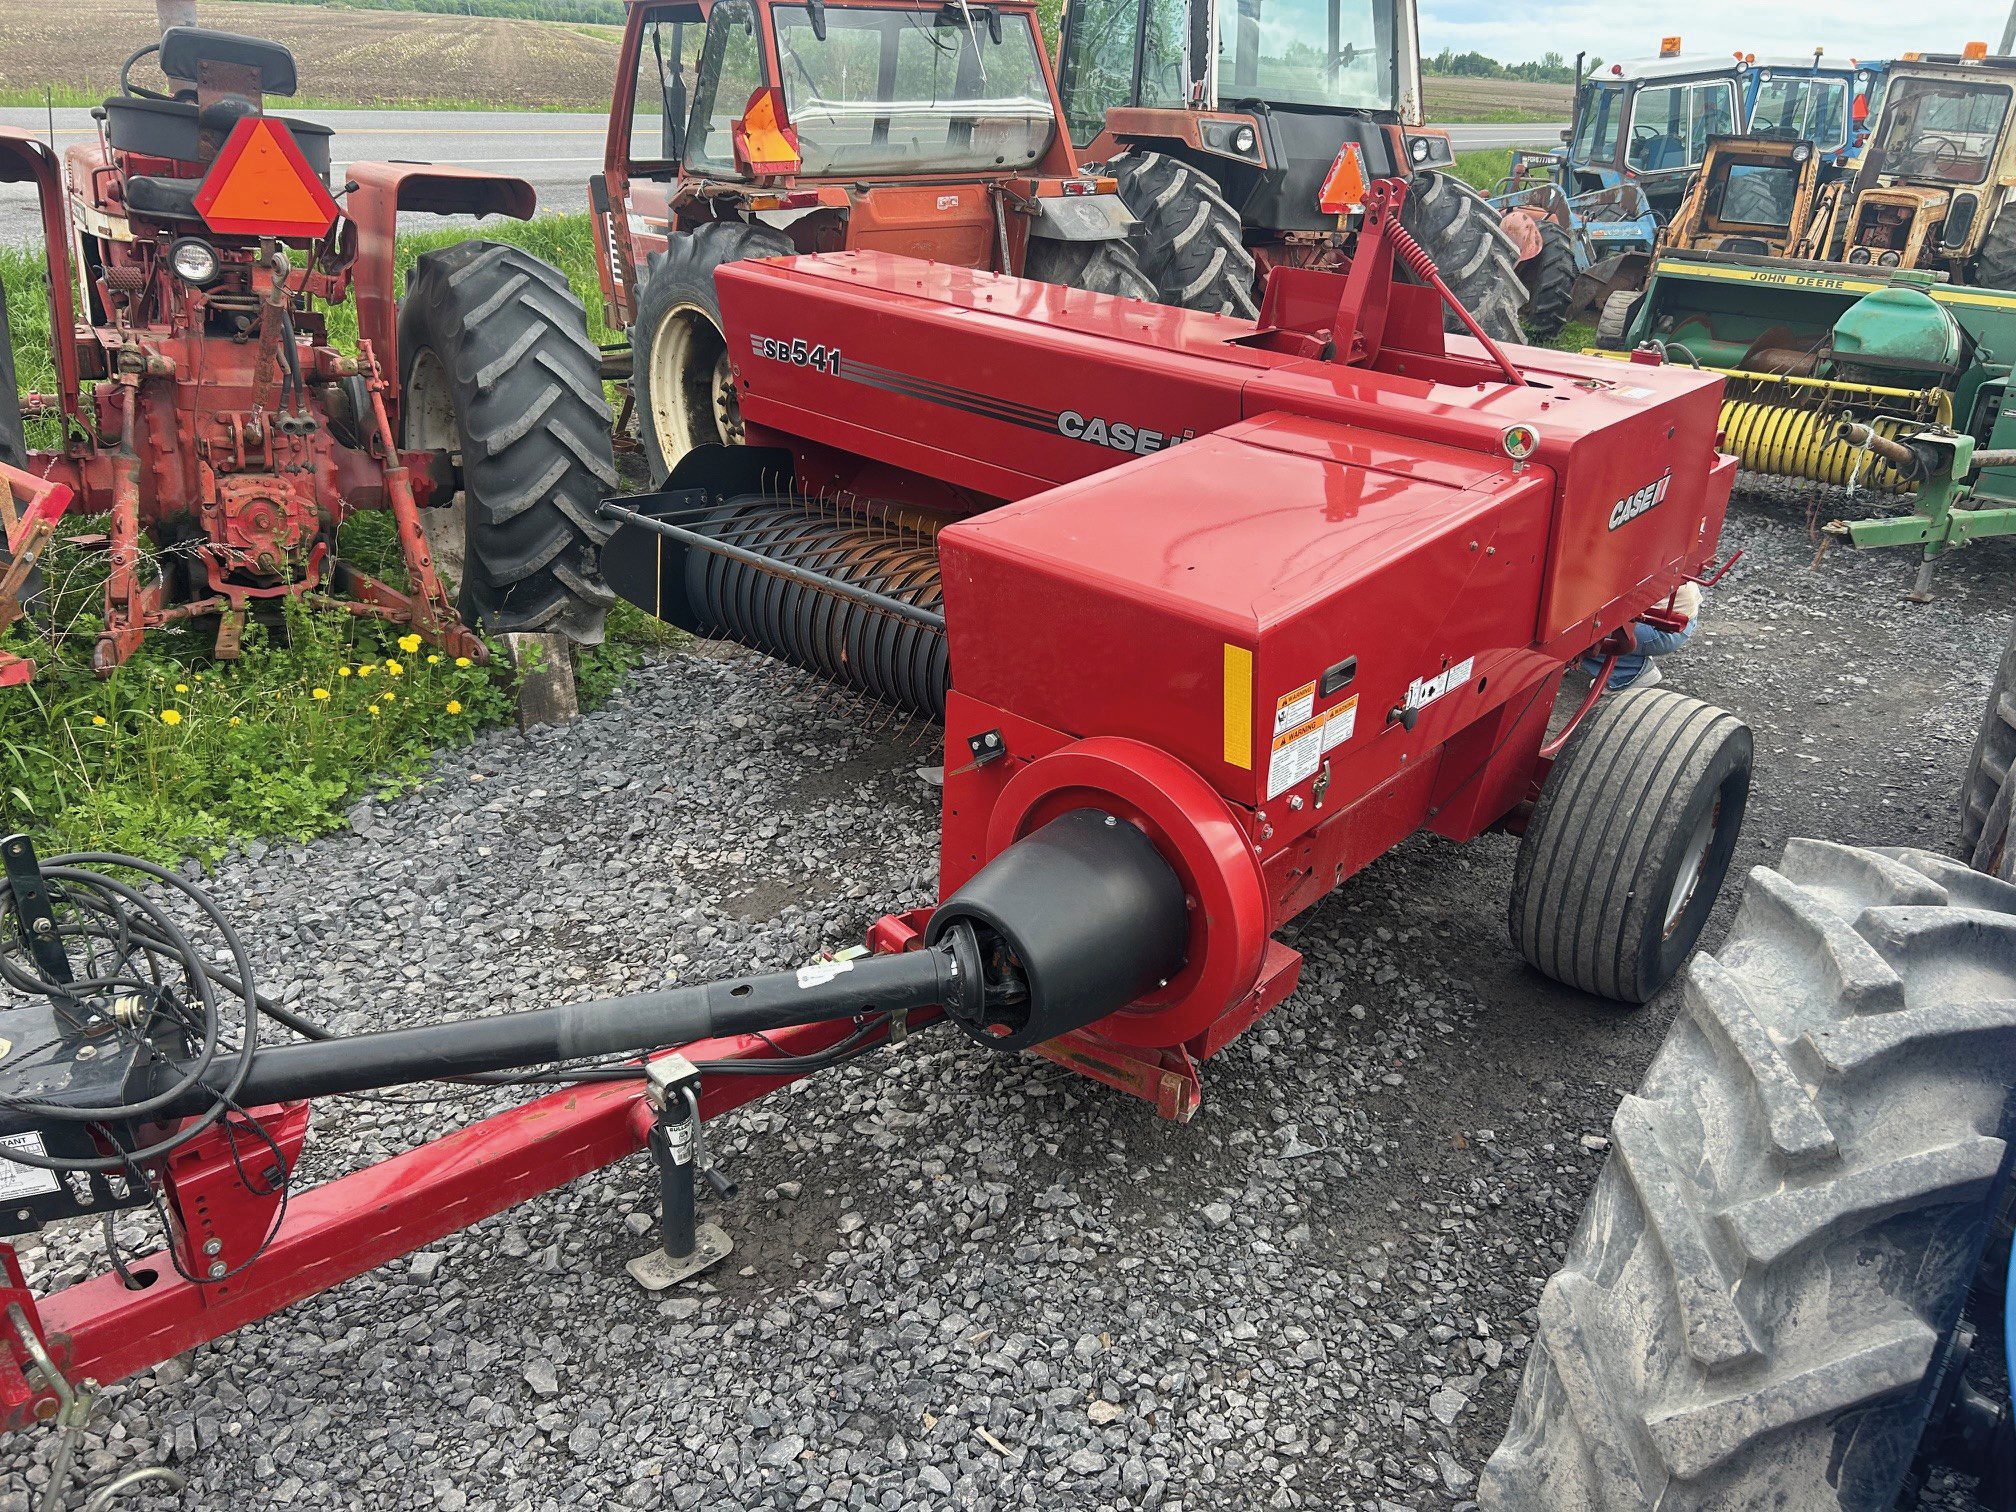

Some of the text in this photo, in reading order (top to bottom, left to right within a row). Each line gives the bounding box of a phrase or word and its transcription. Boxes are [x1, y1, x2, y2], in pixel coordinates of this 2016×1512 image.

[1751, 272, 1844, 289] JOHN DEERE
[763, 337, 841, 378] SB541
[1057, 410, 1163, 455] CASE
[1288, 686, 1312, 701] WARNING
[1334, 700, 1355, 715] WARNING
[1288, 721, 1316, 740] WARNING
